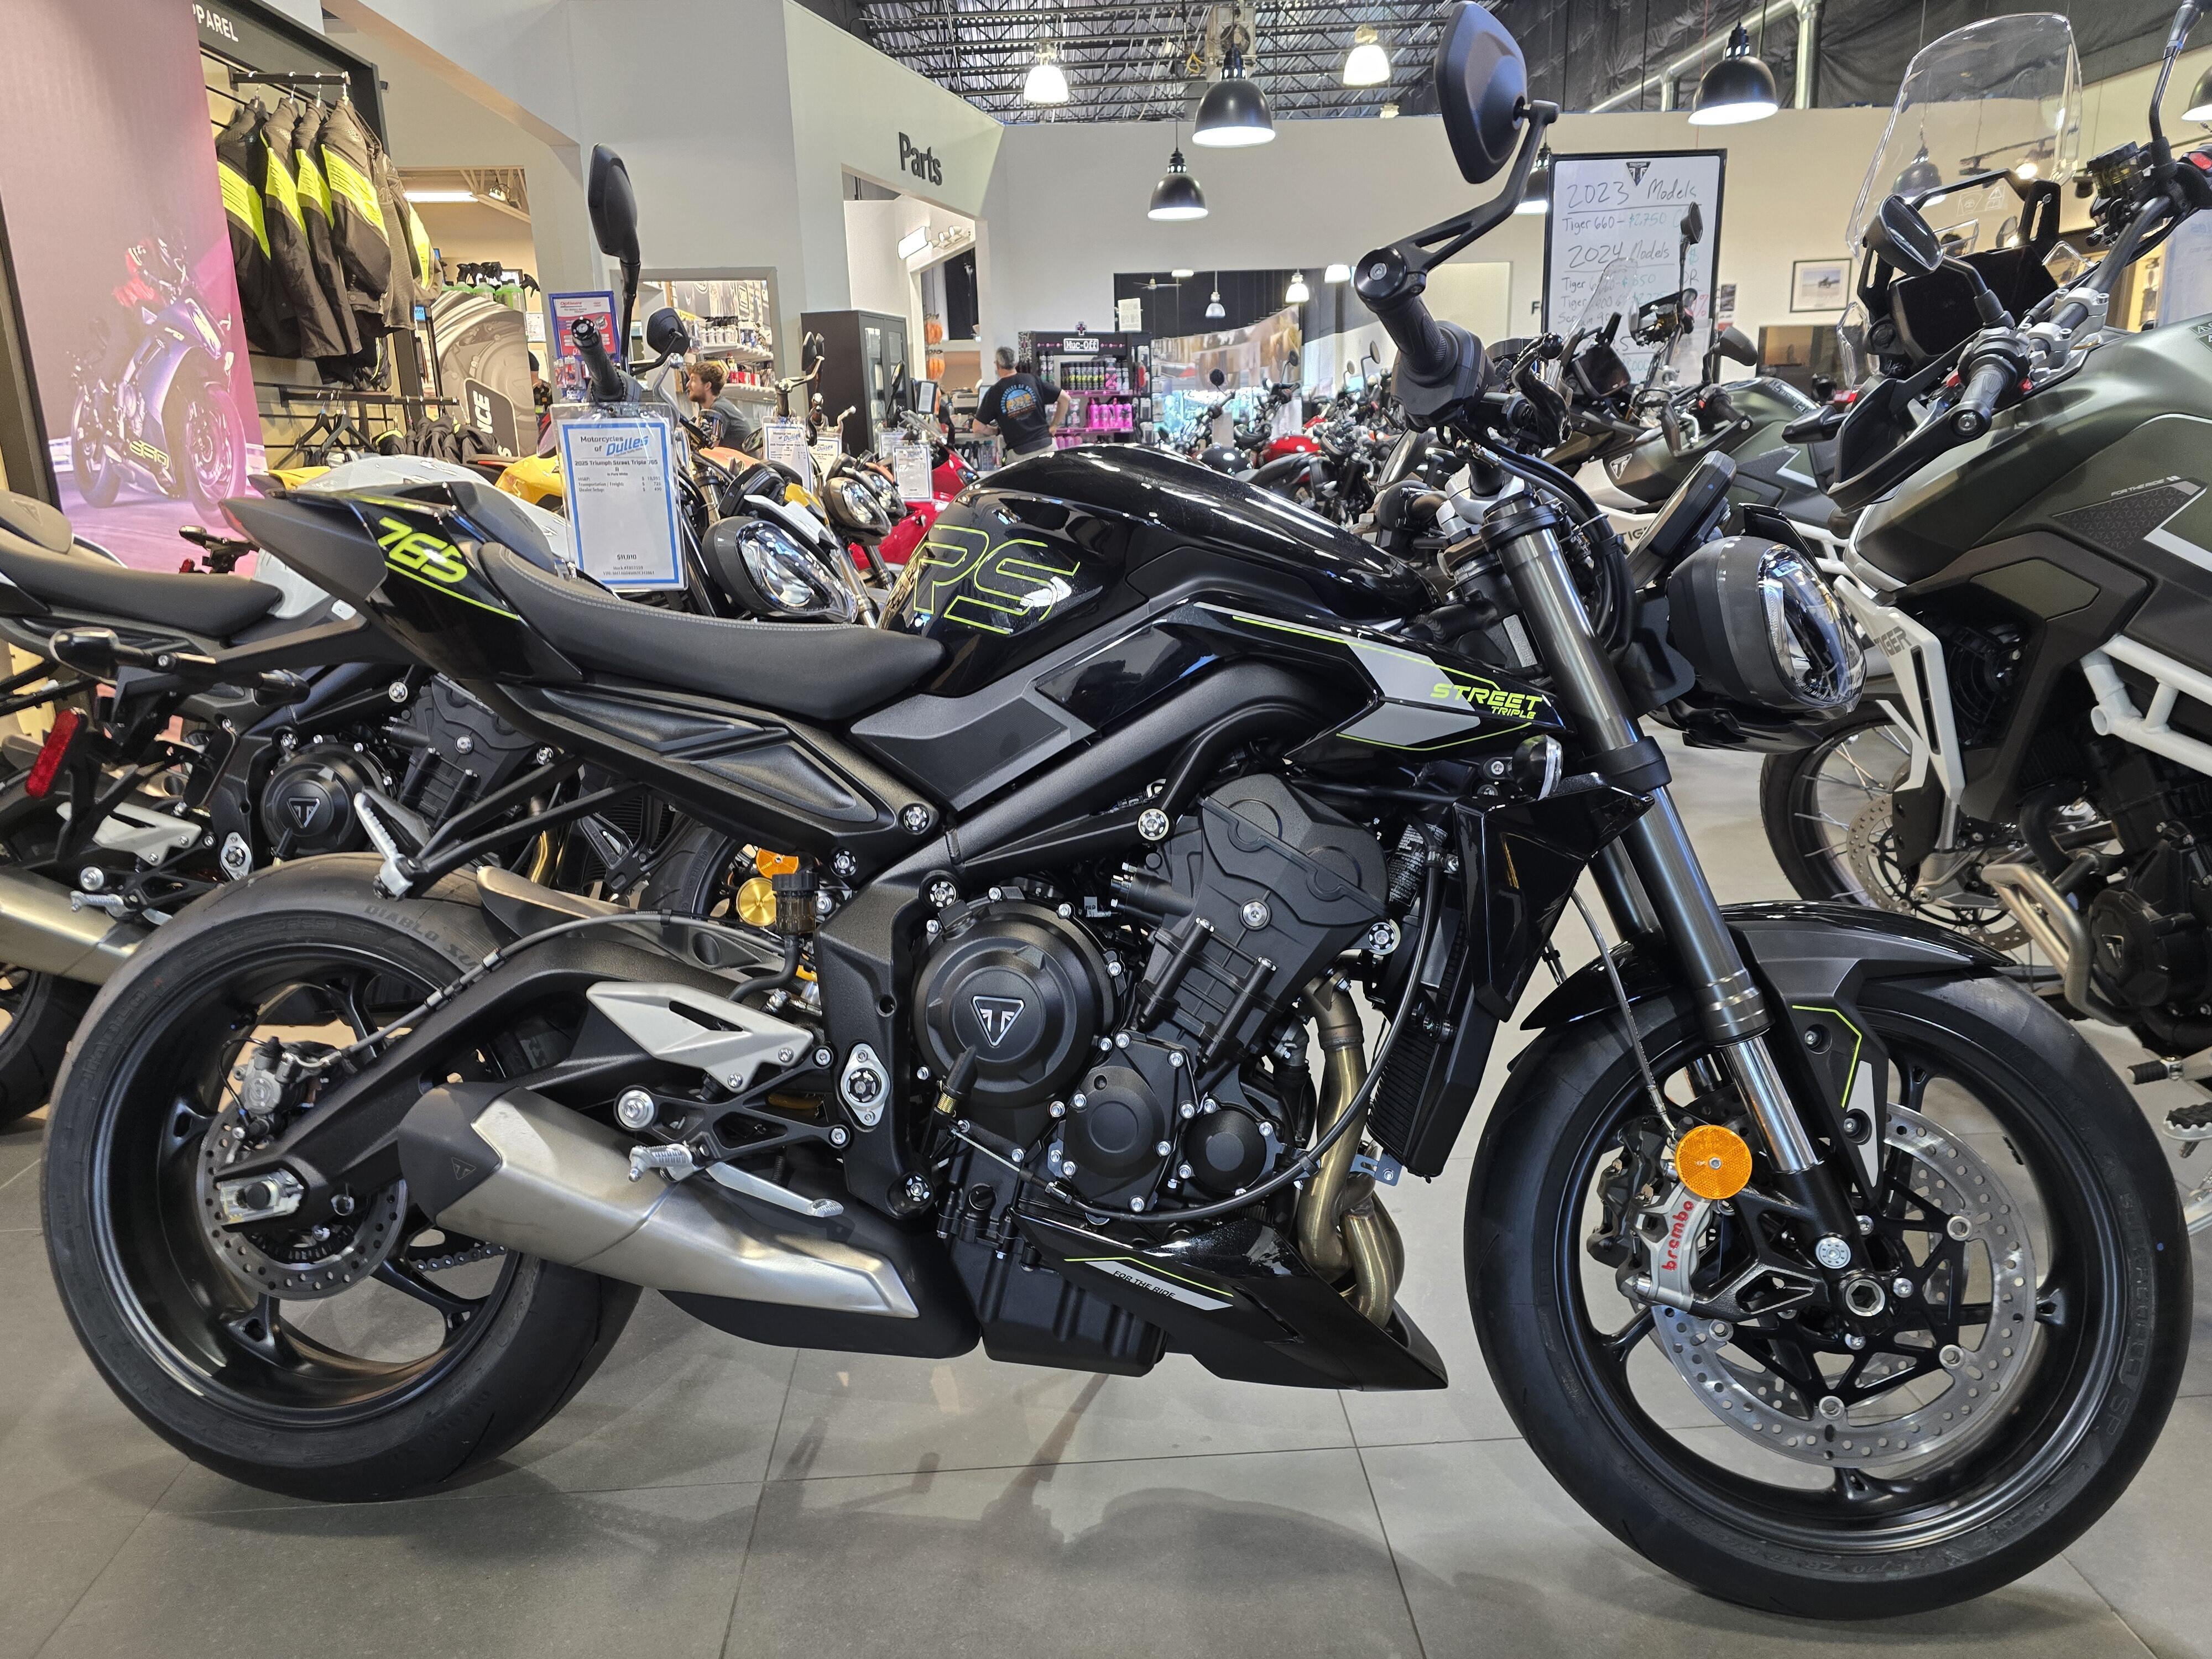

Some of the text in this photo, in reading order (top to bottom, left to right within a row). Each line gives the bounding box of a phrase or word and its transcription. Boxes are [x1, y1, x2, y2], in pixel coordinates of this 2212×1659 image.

[899, 132, 942, 186] Parts
[1567, 178, 1697, 208] 2023 Models
[1562, 218, 1593, 235] Tiger
[1568, 241, 1623, 269] 2024
[1561, 276, 1586, 293] Tiger
[1561, 295, 1587, 311] Tiger
[1066, 340, 1098, 351] Muc-Off
[606, 435, 649, 456] Dulles
[1618, 526, 1648, 541] TIG
[378, 516, 468, 584] 765
[1873, 625, 1912, 658] TIGER
[1430, 682, 1543, 712] STREET
[1491, 706, 1537, 720] TRIPLE
[364, 905, 440, 942] DIABLO
[1661, 1201, 1694, 1271] brembo
[1113, 1270, 1176, 1298] FOR THE RIDE
